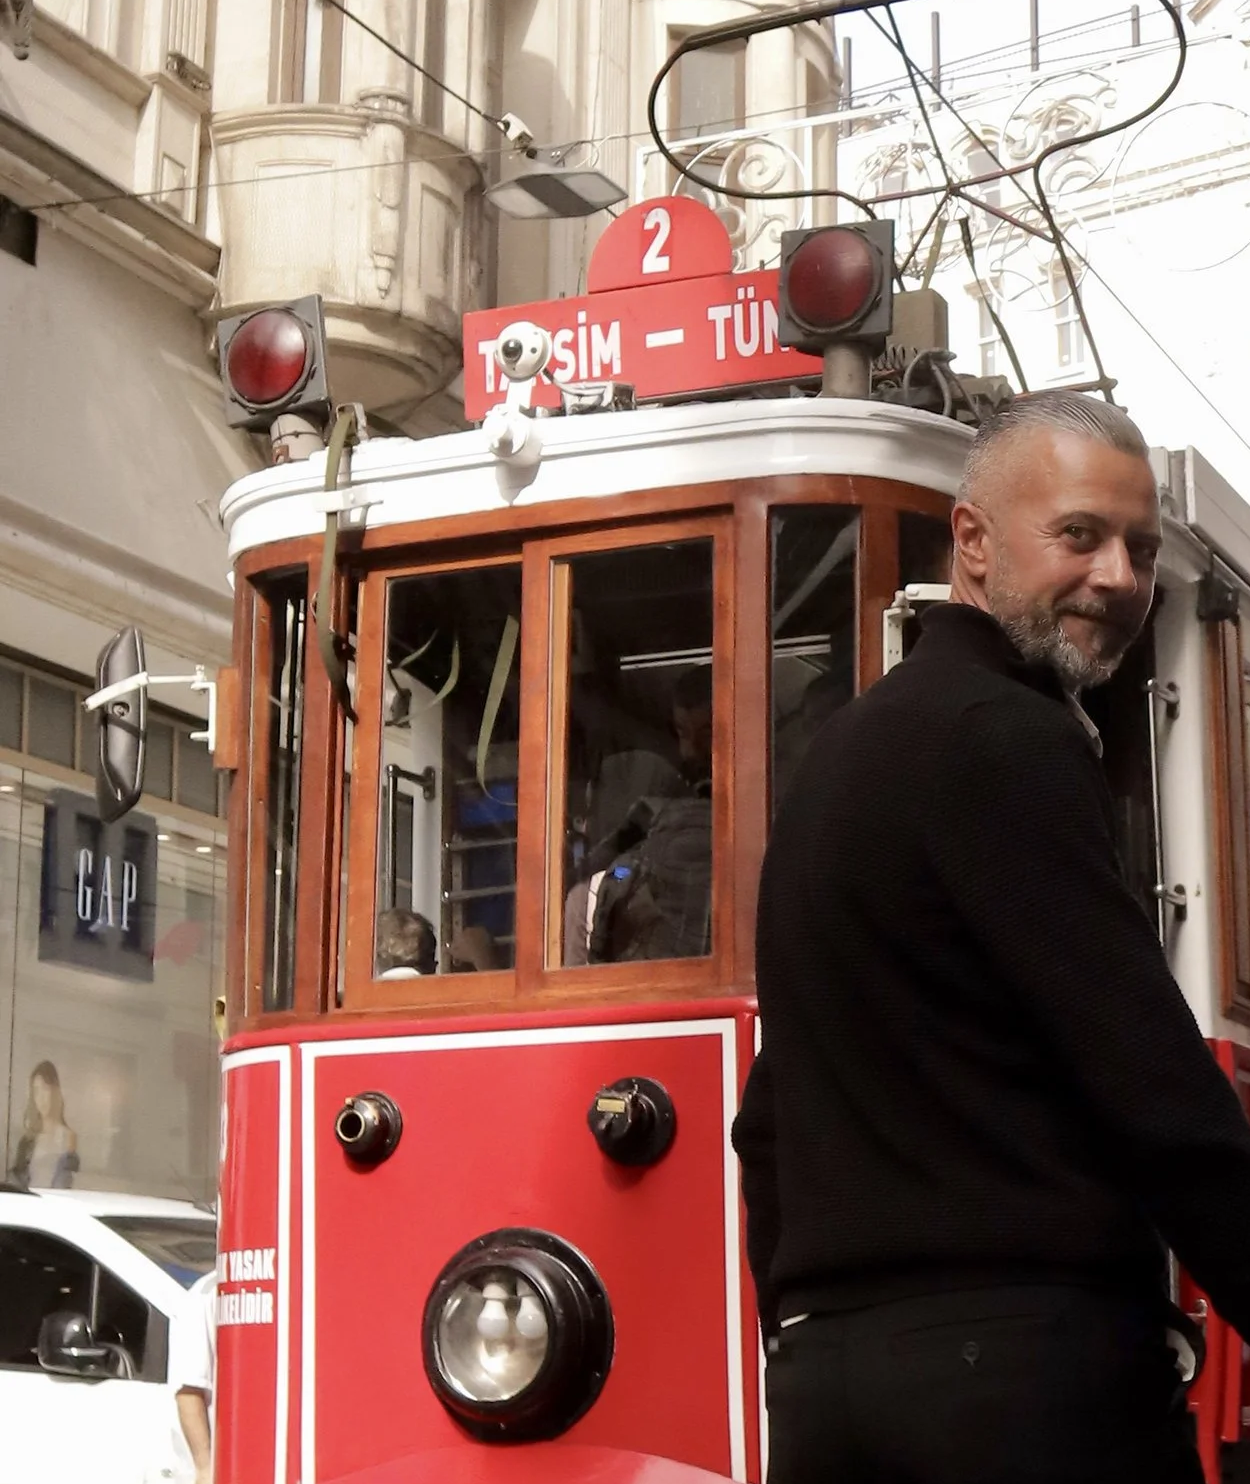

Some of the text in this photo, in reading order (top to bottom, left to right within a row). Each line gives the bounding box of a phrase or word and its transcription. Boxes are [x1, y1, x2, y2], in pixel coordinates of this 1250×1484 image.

[642, 207, 671, 274] 2
[478, 310, 621, 393] TSİM
[707, 286, 790, 360] TÜN
[78, 848, 137, 931] GAP
[229, 1248, 276, 1282] YASAK
